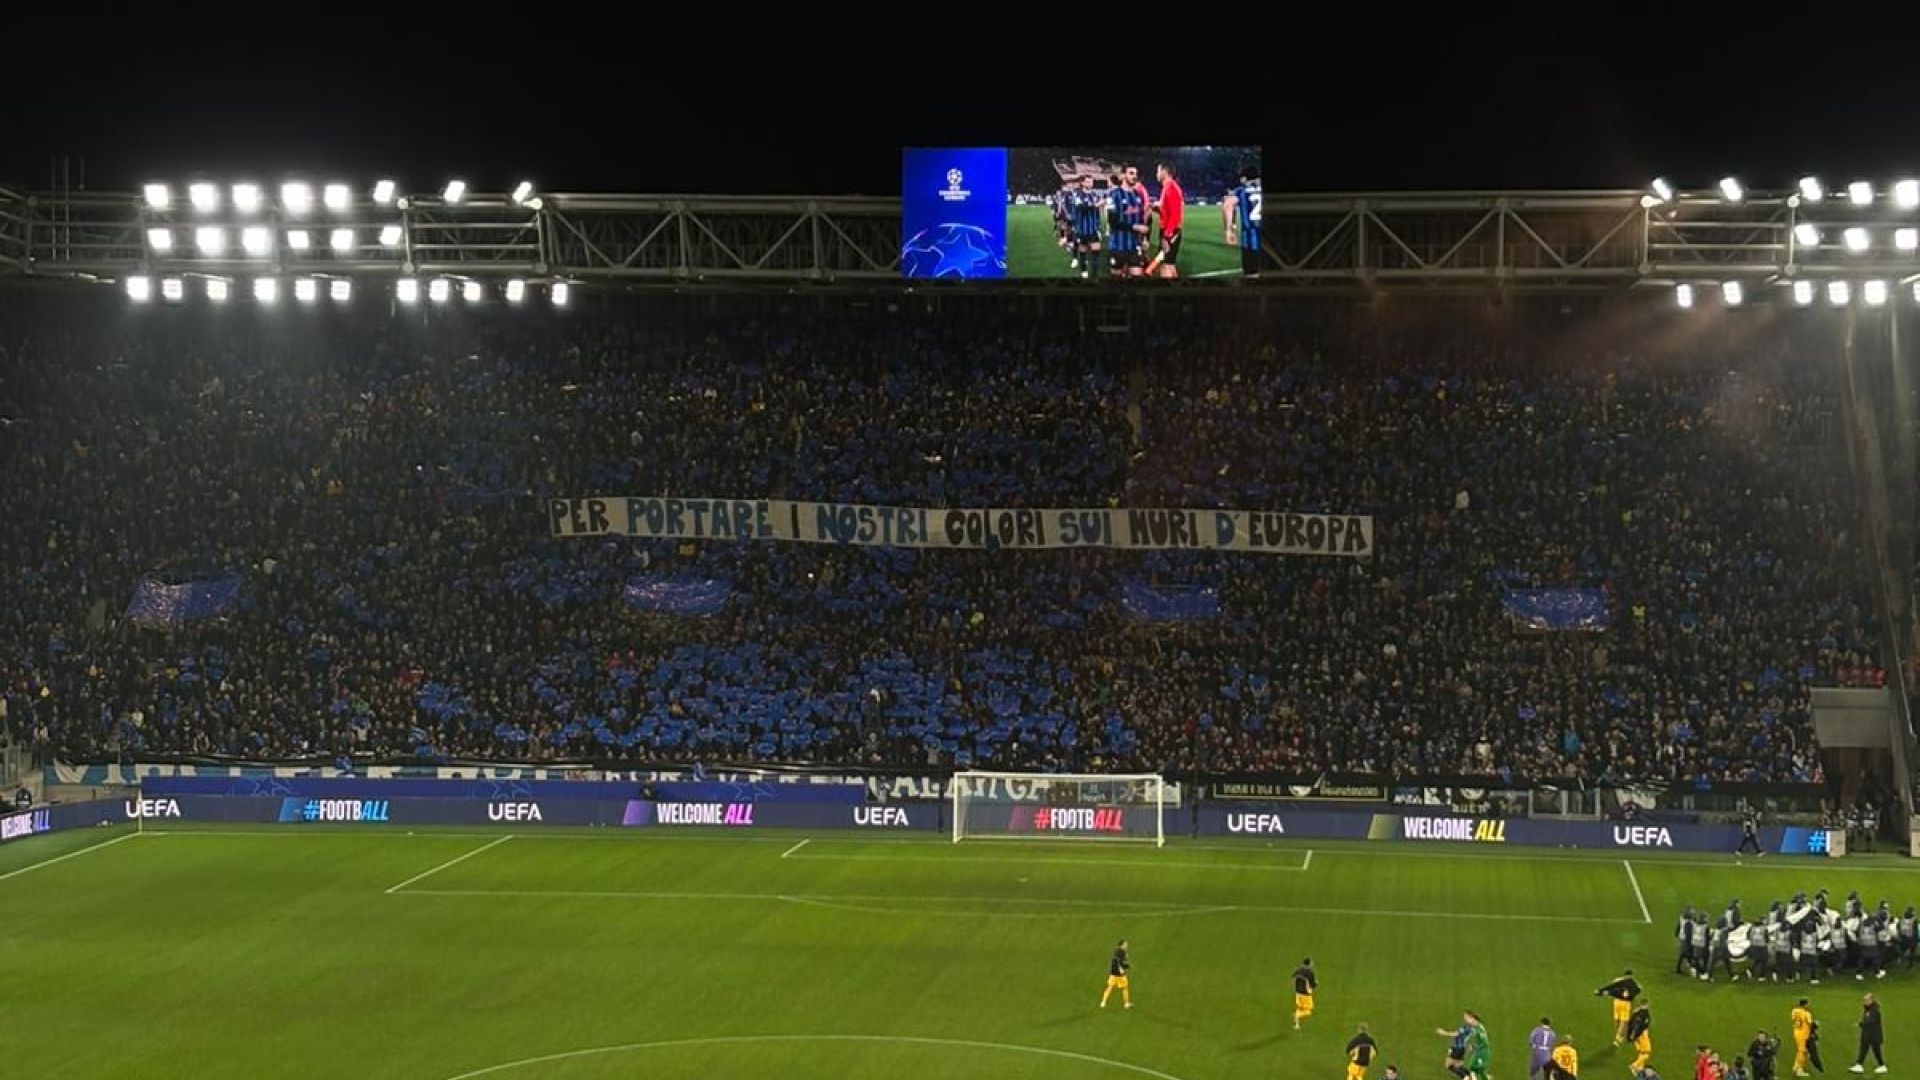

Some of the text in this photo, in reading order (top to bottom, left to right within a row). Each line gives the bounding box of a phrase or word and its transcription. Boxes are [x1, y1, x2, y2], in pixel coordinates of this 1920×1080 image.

[553, 500, 609, 534] PER
[627, 499, 772, 538] PORTARE
[791, 505, 799, 537] I
[816, 505, 928, 544] NOSTRI
[945, 510, 1046, 546] COLORI
[1060, 511, 1112, 546] SUI
[1130, 512, 1199, 546] MURI
[125, 798, 181, 818] UEFA
[303, 799, 389, 821] #FOOTBALL
[488, 802, 542, 821] UEFA
[656, 802, 753, 824] WELCOME ALL
[853, 806, 909, 826] UEFA
[1034, 808, 1123, 831] #FOOTBALL
[1227, 813, 1284, 833] UEFA
[1403, 816, 1505, 841] WELCOME ALL
[1614, 825, 1673, 846] UEFA
